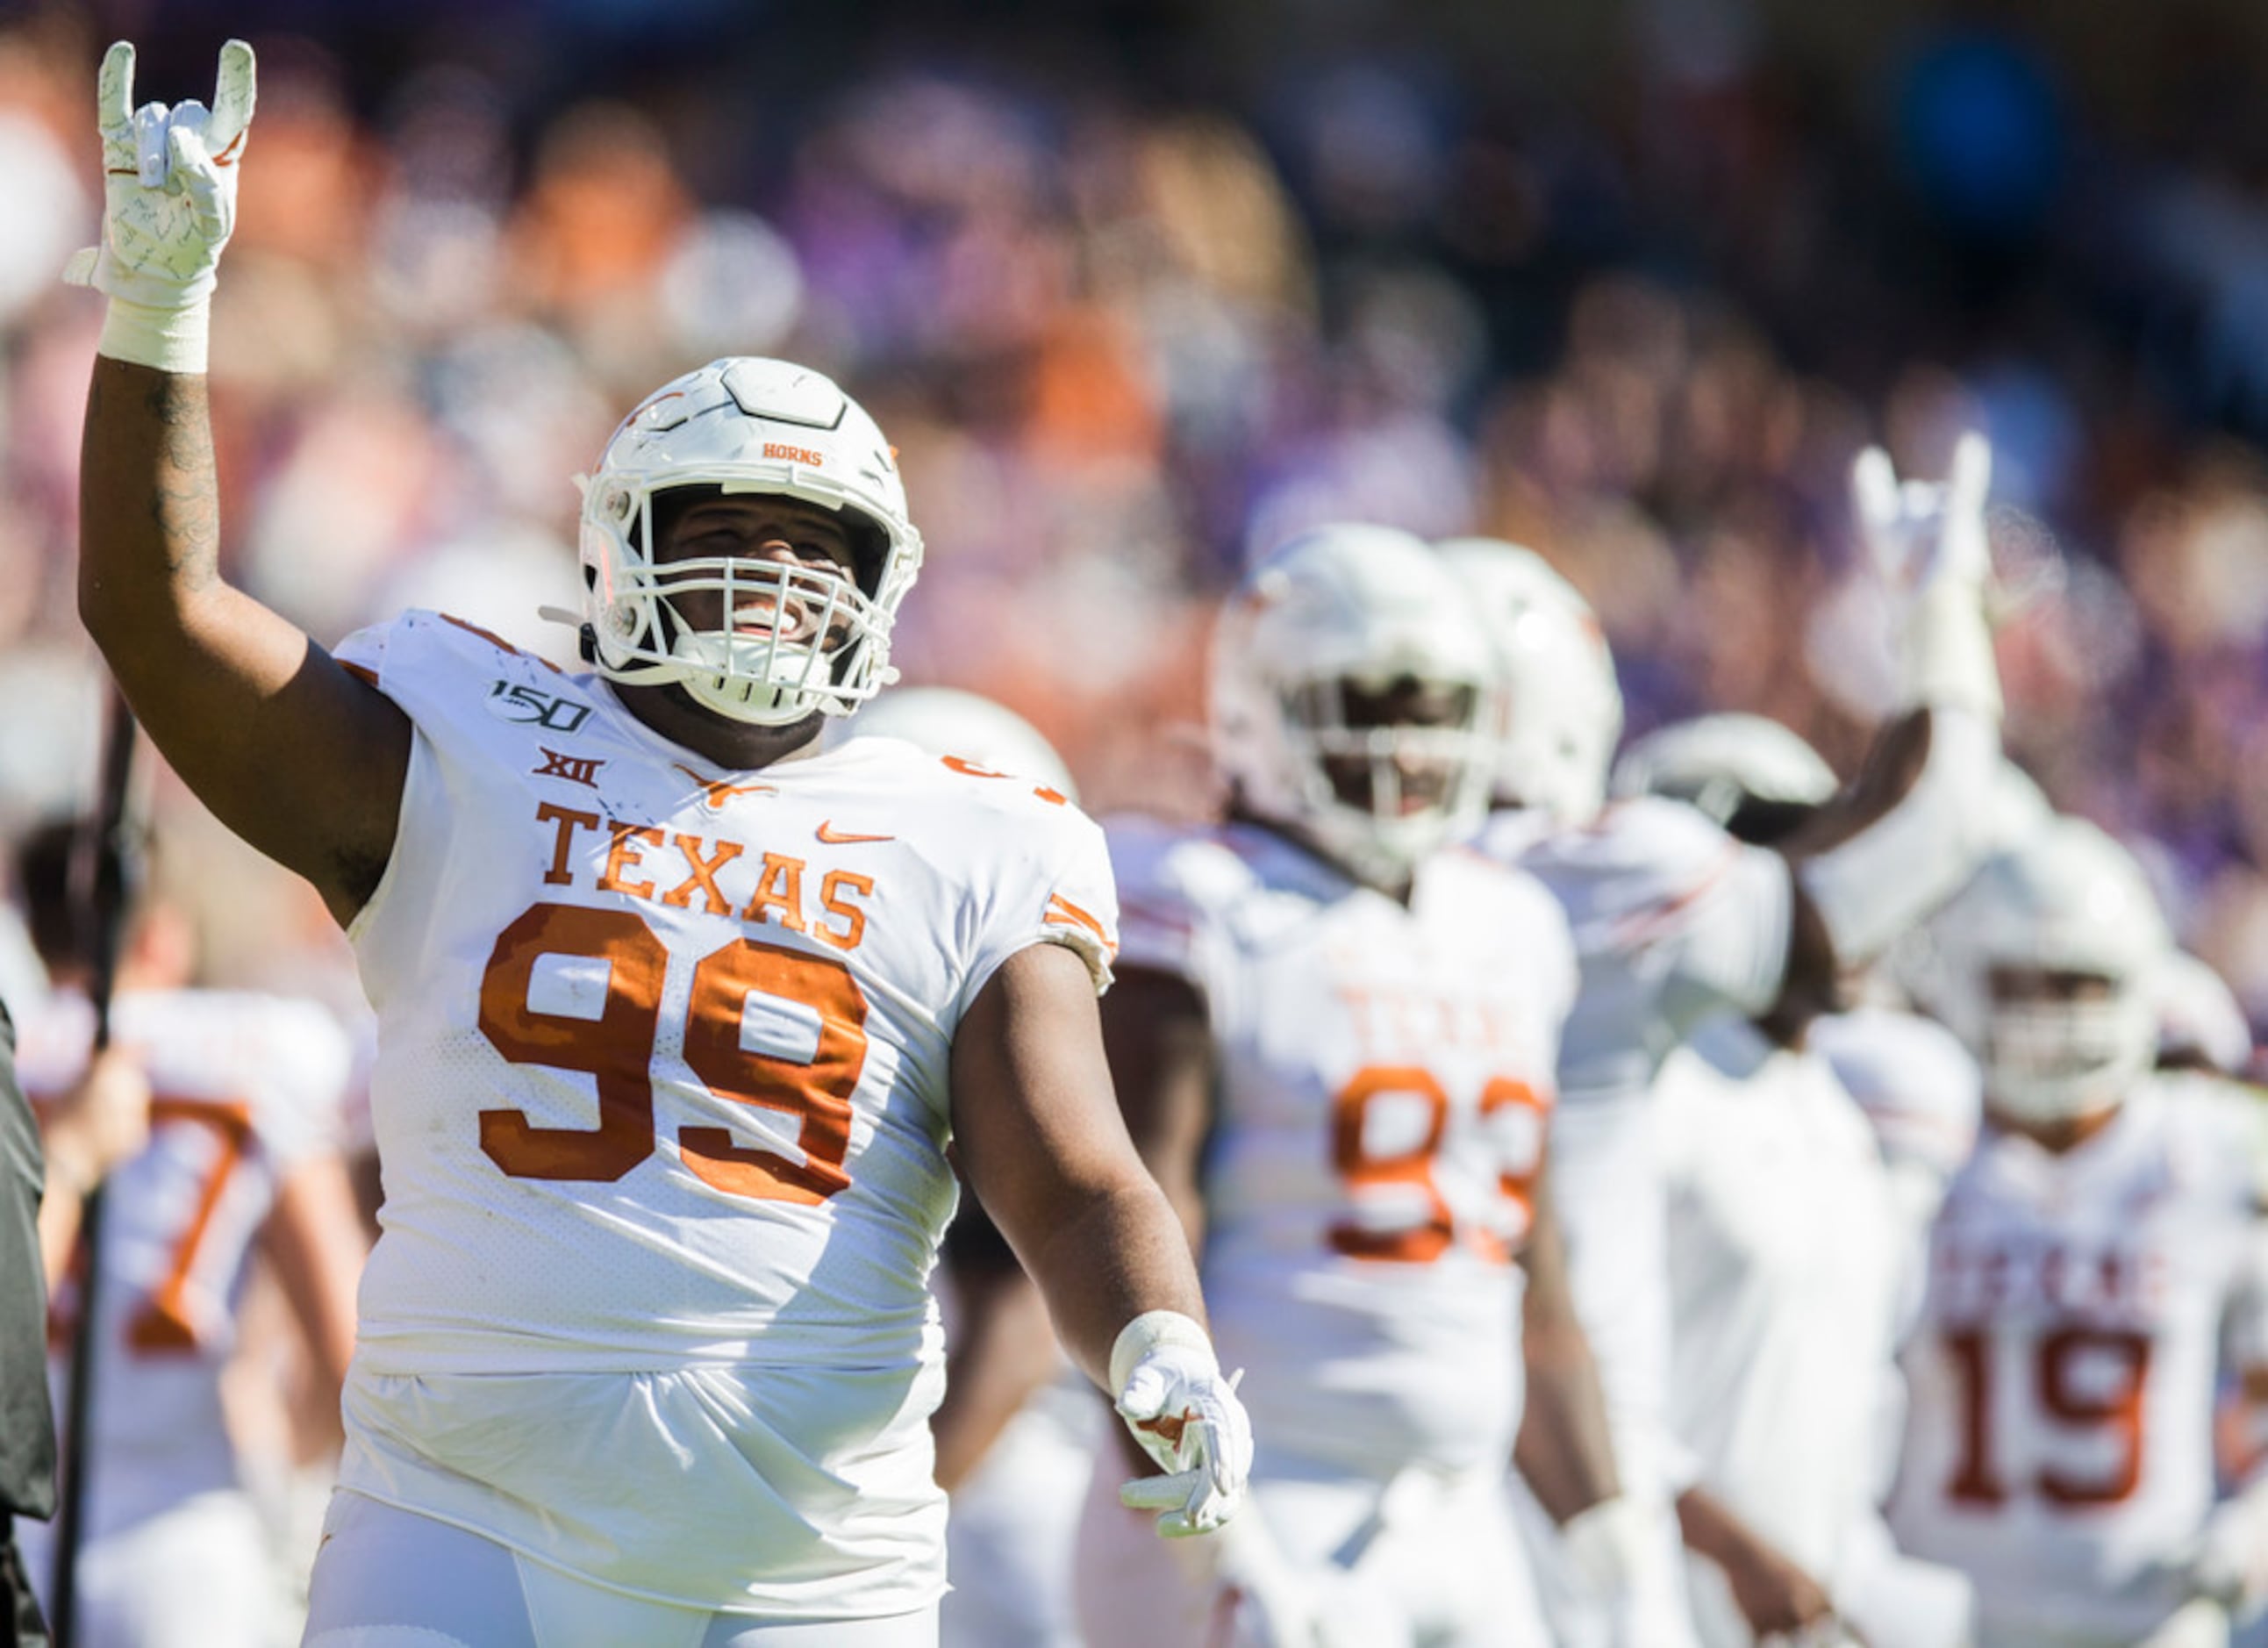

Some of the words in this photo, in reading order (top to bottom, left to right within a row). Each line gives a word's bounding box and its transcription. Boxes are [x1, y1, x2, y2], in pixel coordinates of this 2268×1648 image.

[763, 442, 822, 467] HORNS
[492, 679, 591, 732] 150
[532, 746, 606, 789] XII
[536, 802, 874, 951] TEXAS
[478, 901, 869, 1207] 99
[1942, 1323, 2152, 1508] 19
